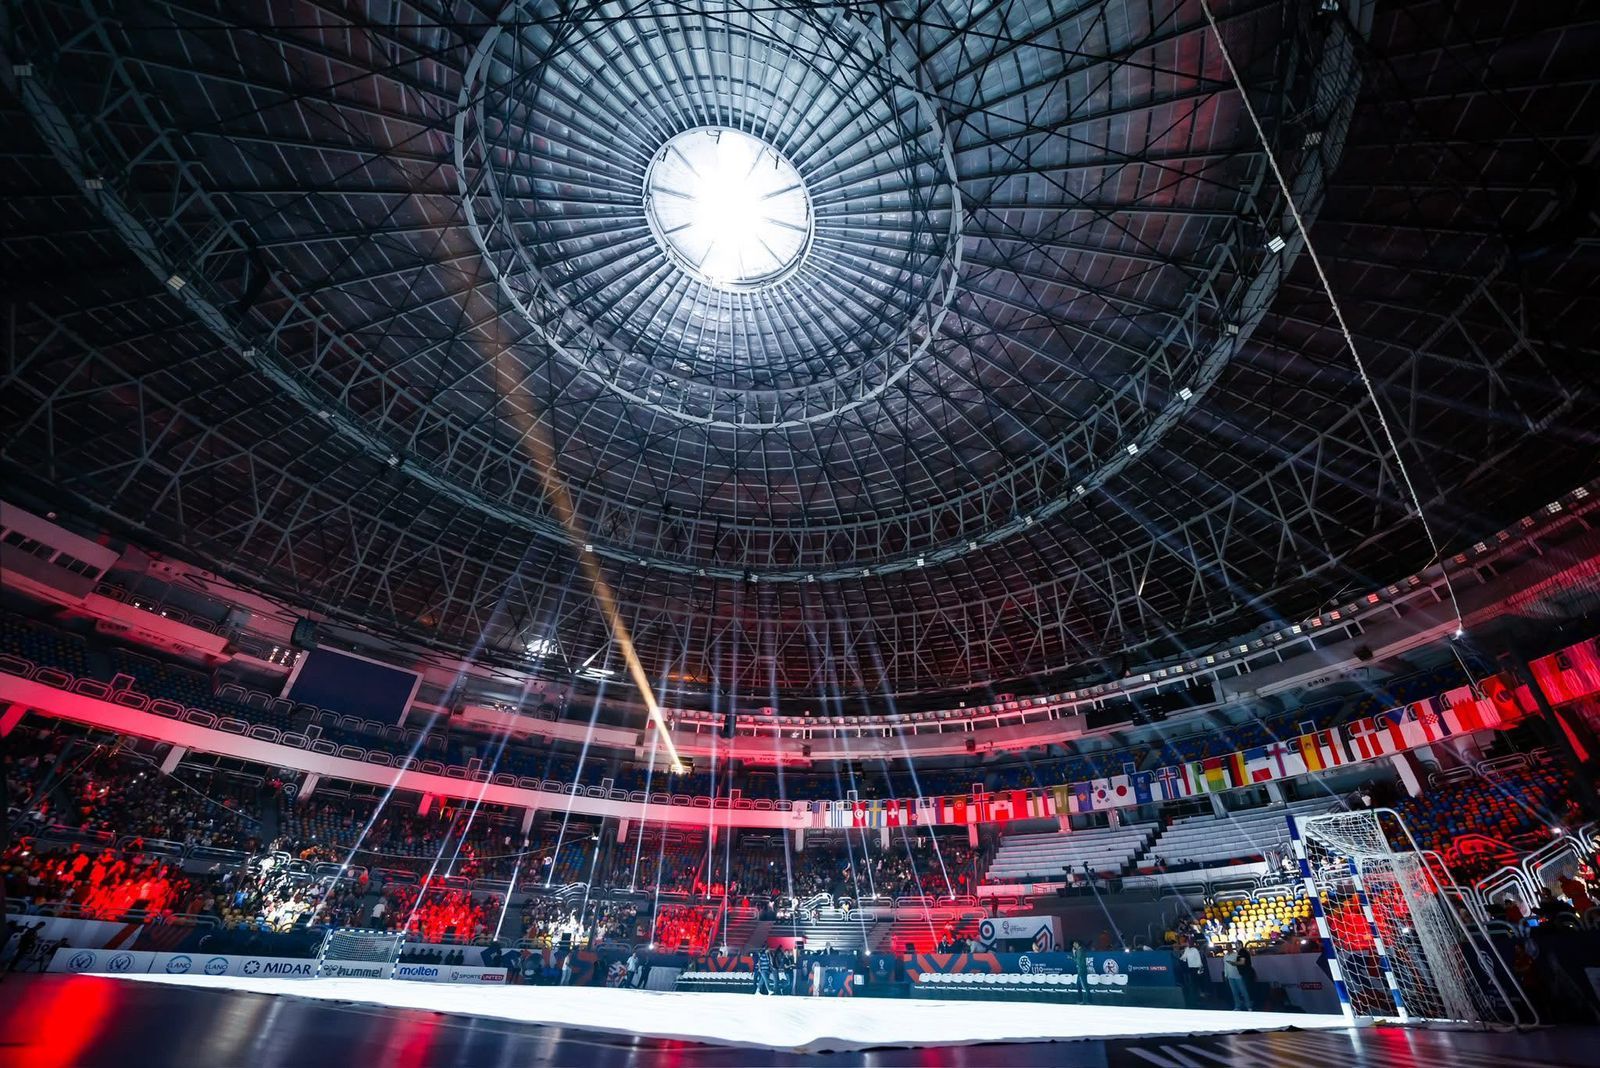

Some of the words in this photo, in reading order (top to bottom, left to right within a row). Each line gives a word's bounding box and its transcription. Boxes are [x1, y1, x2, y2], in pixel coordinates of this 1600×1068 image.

[263, 963, 312, 975] MIDAR
[337, 966, 383, 978] hummel
[399, 967, 439, 977] molten
